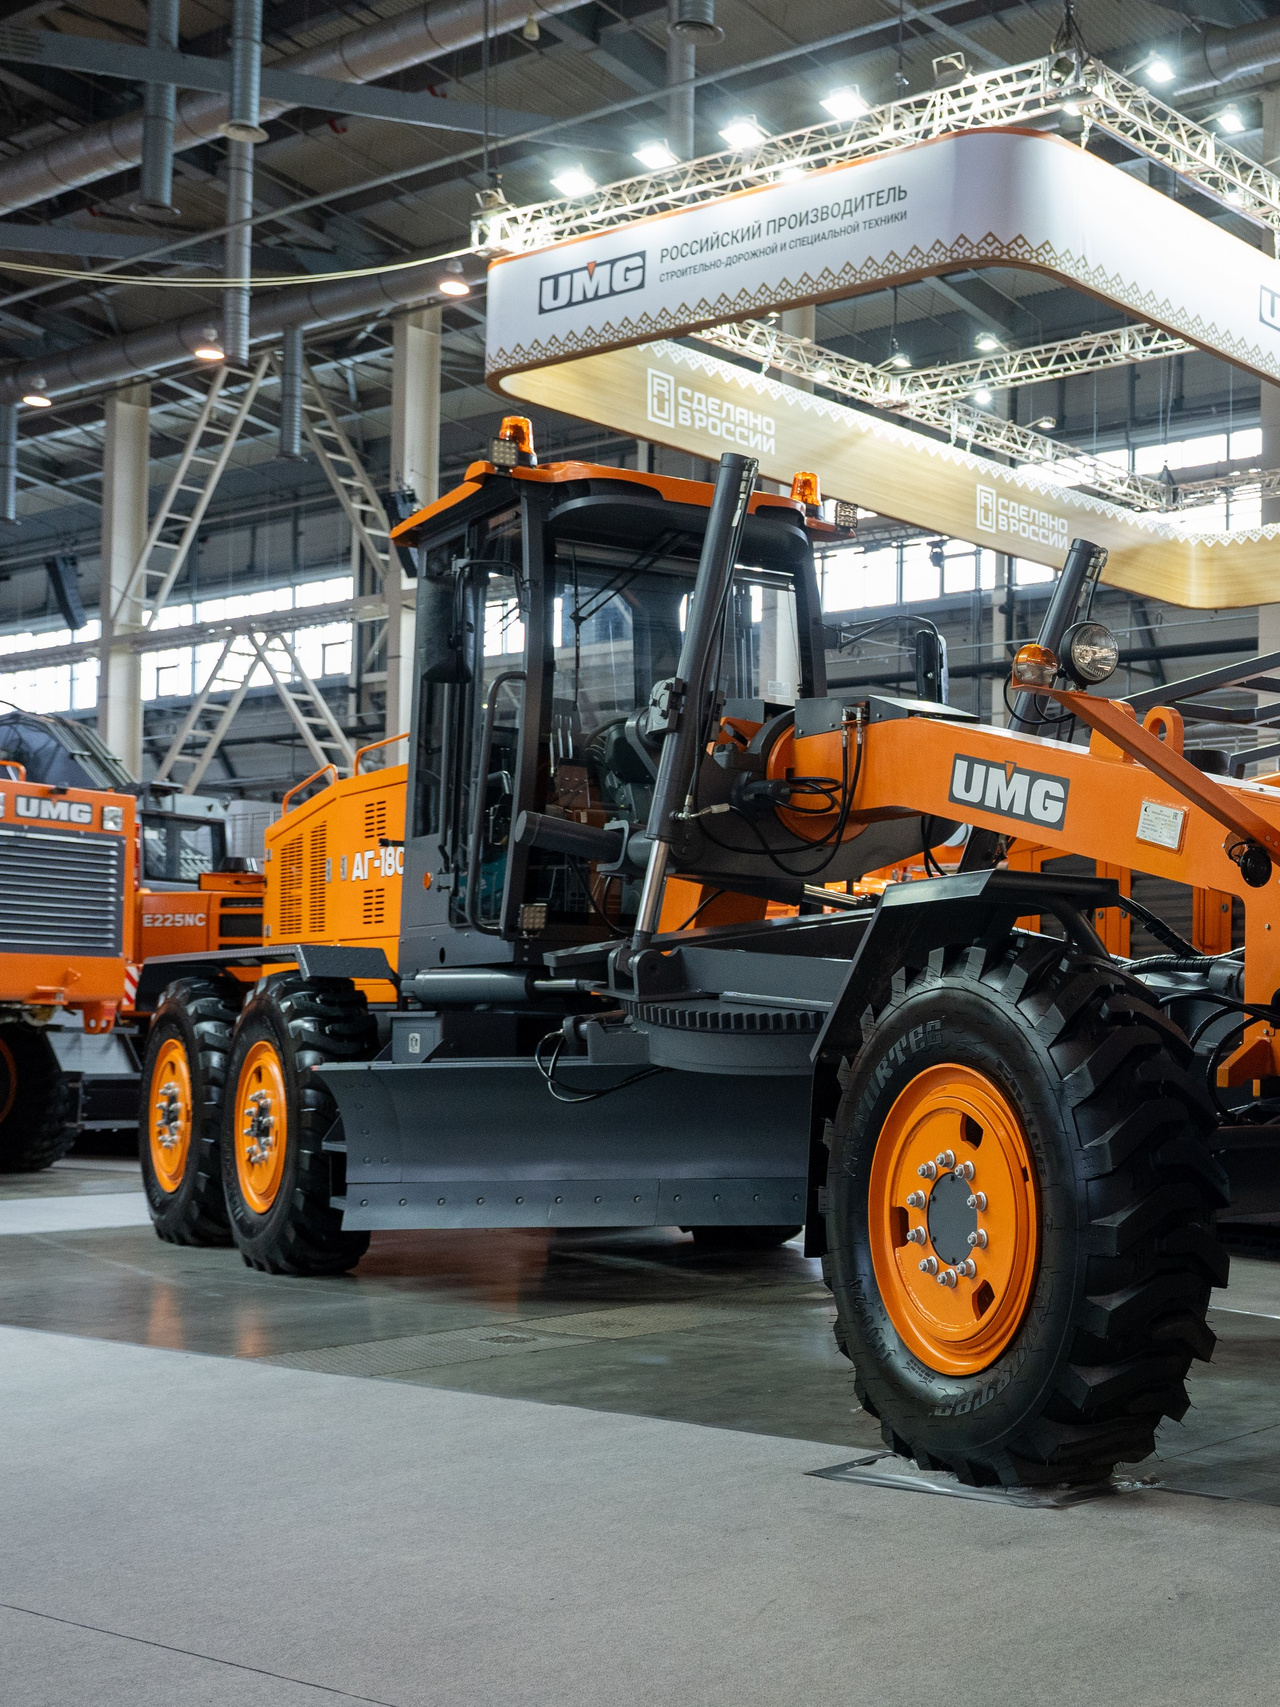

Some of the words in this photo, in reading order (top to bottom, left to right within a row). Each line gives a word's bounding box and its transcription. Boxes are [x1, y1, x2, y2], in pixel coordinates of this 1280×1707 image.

[659, 242, 778, 283] СТРОИТЕЛЬНО-ДОРОЖНОЙ
[780, 241, 787, 252] И
[788, 221, 860, 250] СПЕЦИАЛЬНОЙ
[862, 210, 908, 231] ТЕХНИКИ
[660, 220, 762, 263] РОССИЙСКИЙ
[766, 185, 908, 236] ПРОИЗВОДИТЕЛЬ
[541, 254, 645, 312] UMG
[677, 386, 776, 436] СДЕЛАНО
[998, 497, 1069, 534] СДЕЛАНО
[16, 797, 92, 824] UMG
[952, 758, 1066, 824] UMG
[142, 912, 207, 928] E225NC
